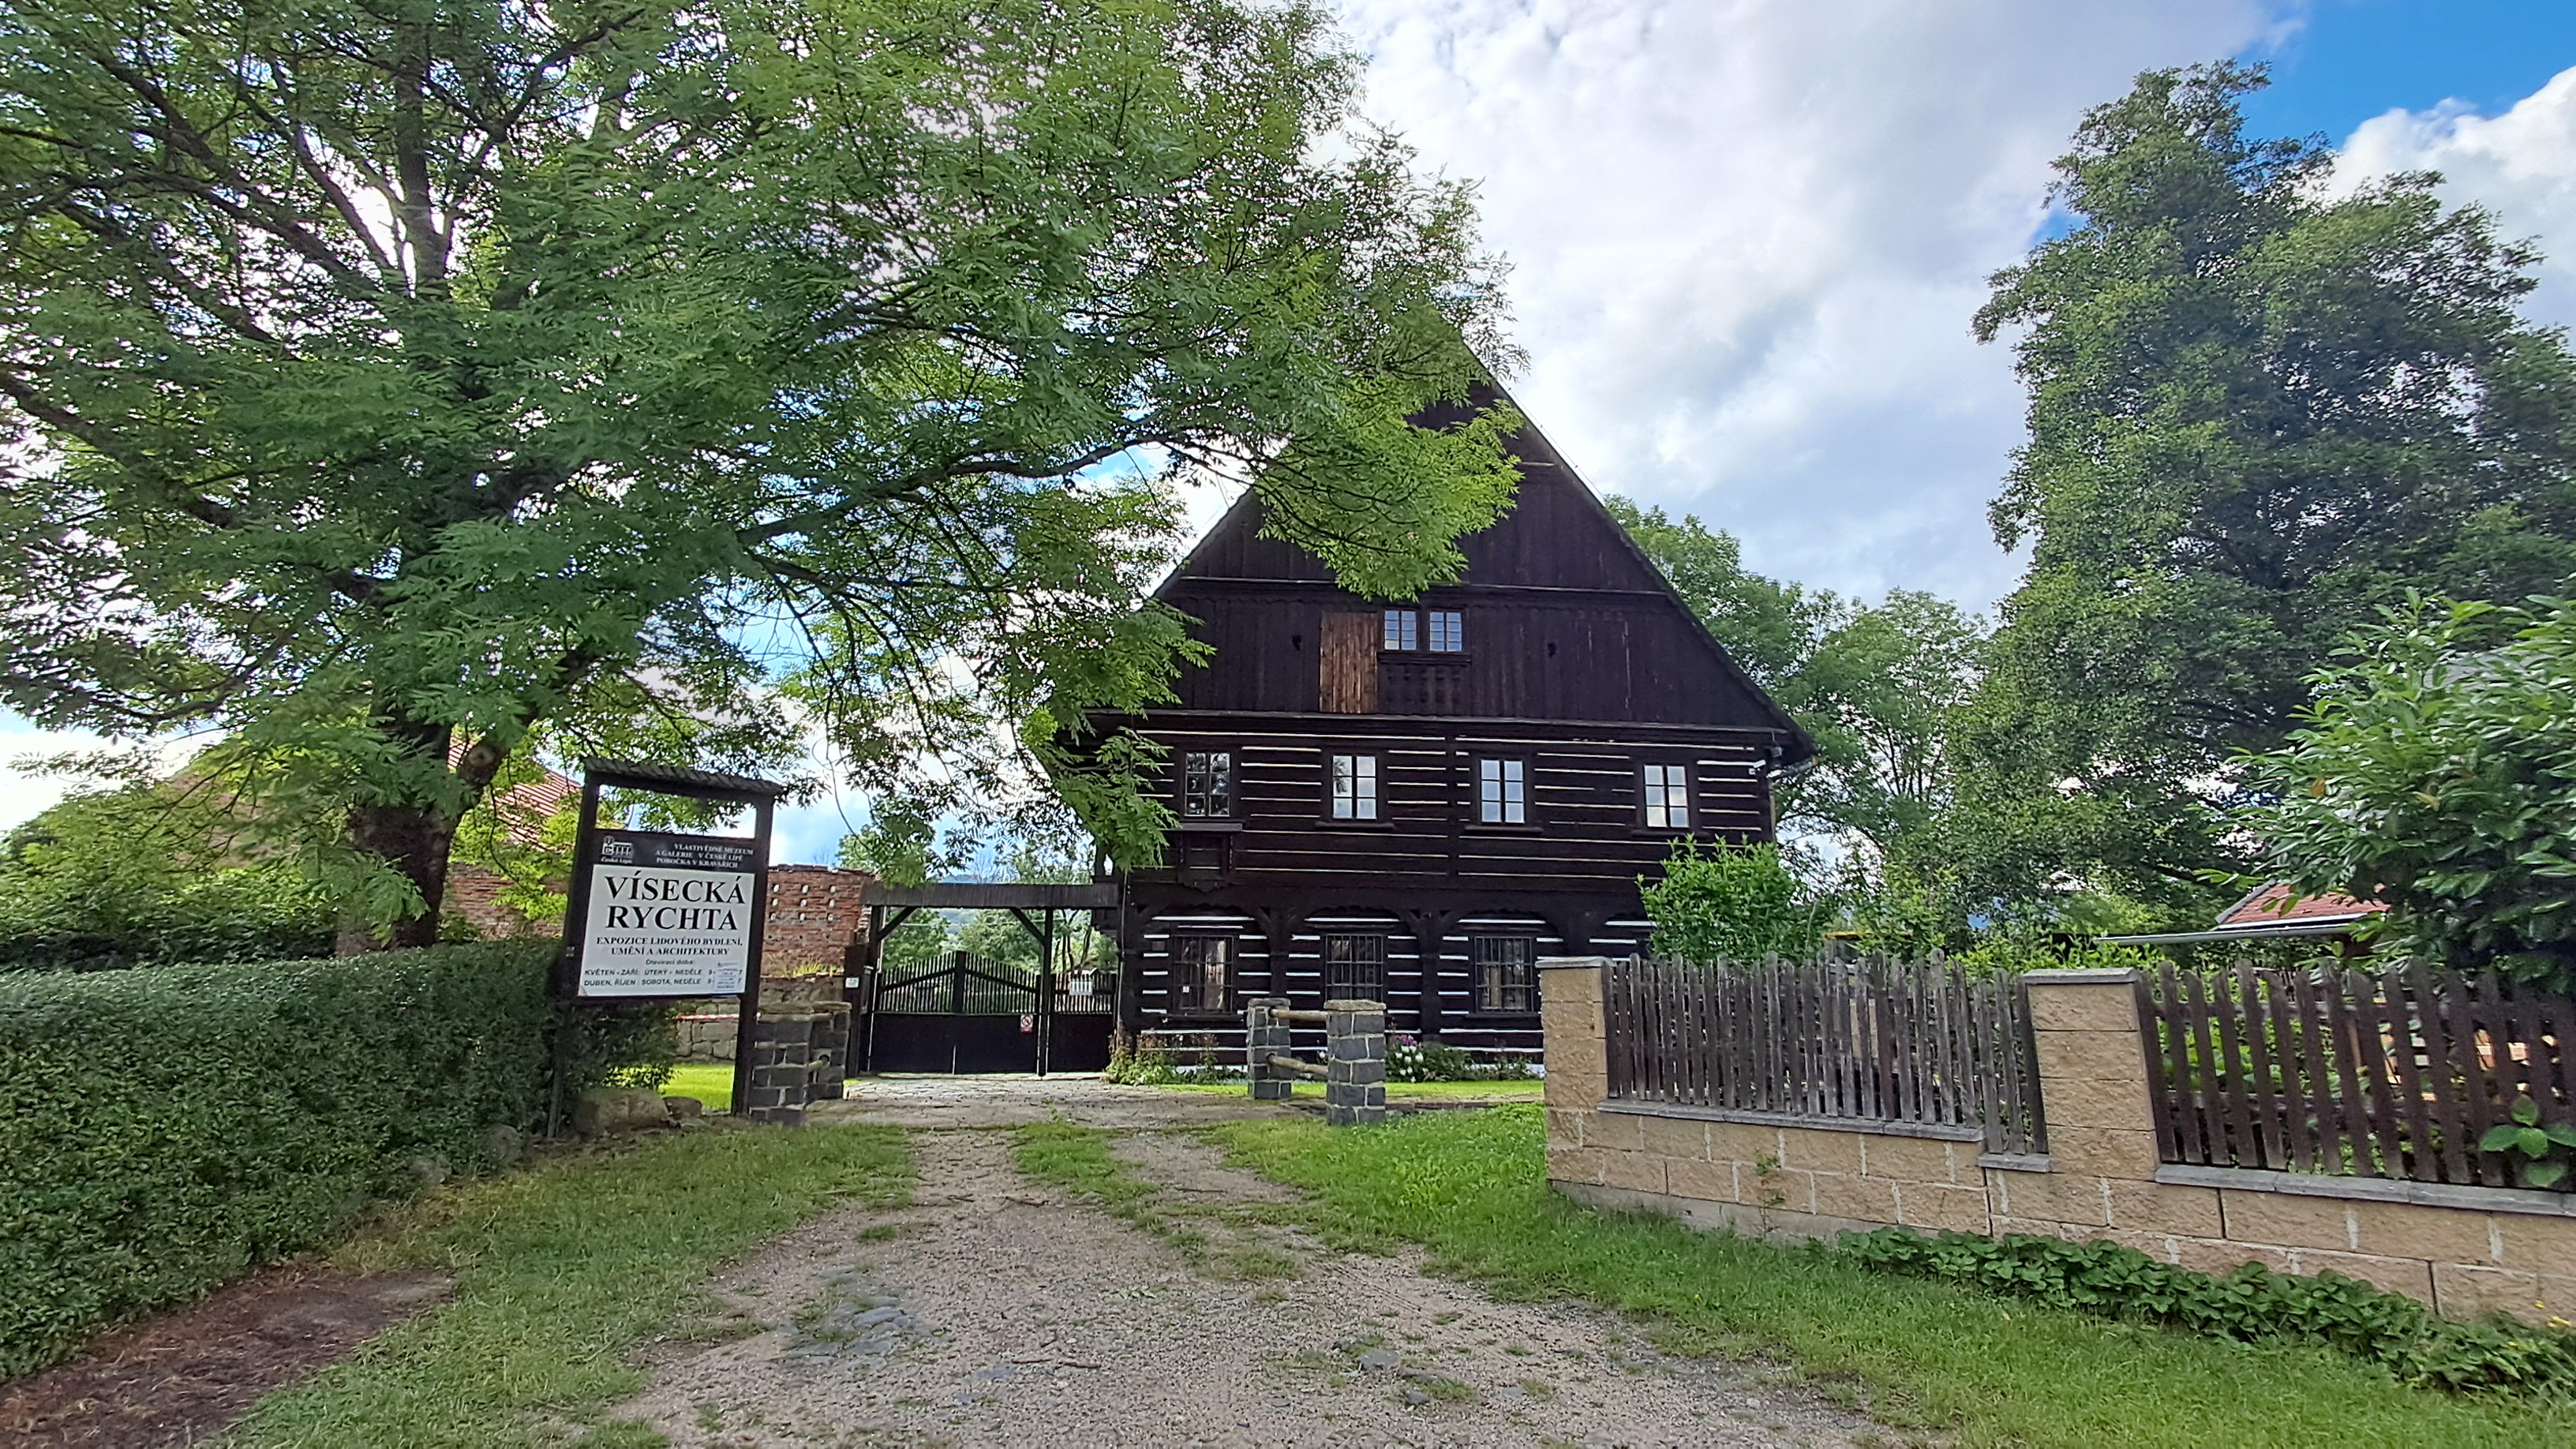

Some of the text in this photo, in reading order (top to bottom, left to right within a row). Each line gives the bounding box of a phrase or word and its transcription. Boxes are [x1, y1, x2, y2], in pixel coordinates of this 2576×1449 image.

[724, 847, 754, 856] MUZEUM
[698, 859, 738, 868] KRAVAŘÍCH
[605, 871, 745, 904] VÍSECKÁ
[605, 905, 738, 930] RYCHTA
[650, 936, 701, 945] LIDOVÉHO
[703, 937, 743, 946] BYDLENÍ,
[612, 945, 645, 955] UMĚNÍ
